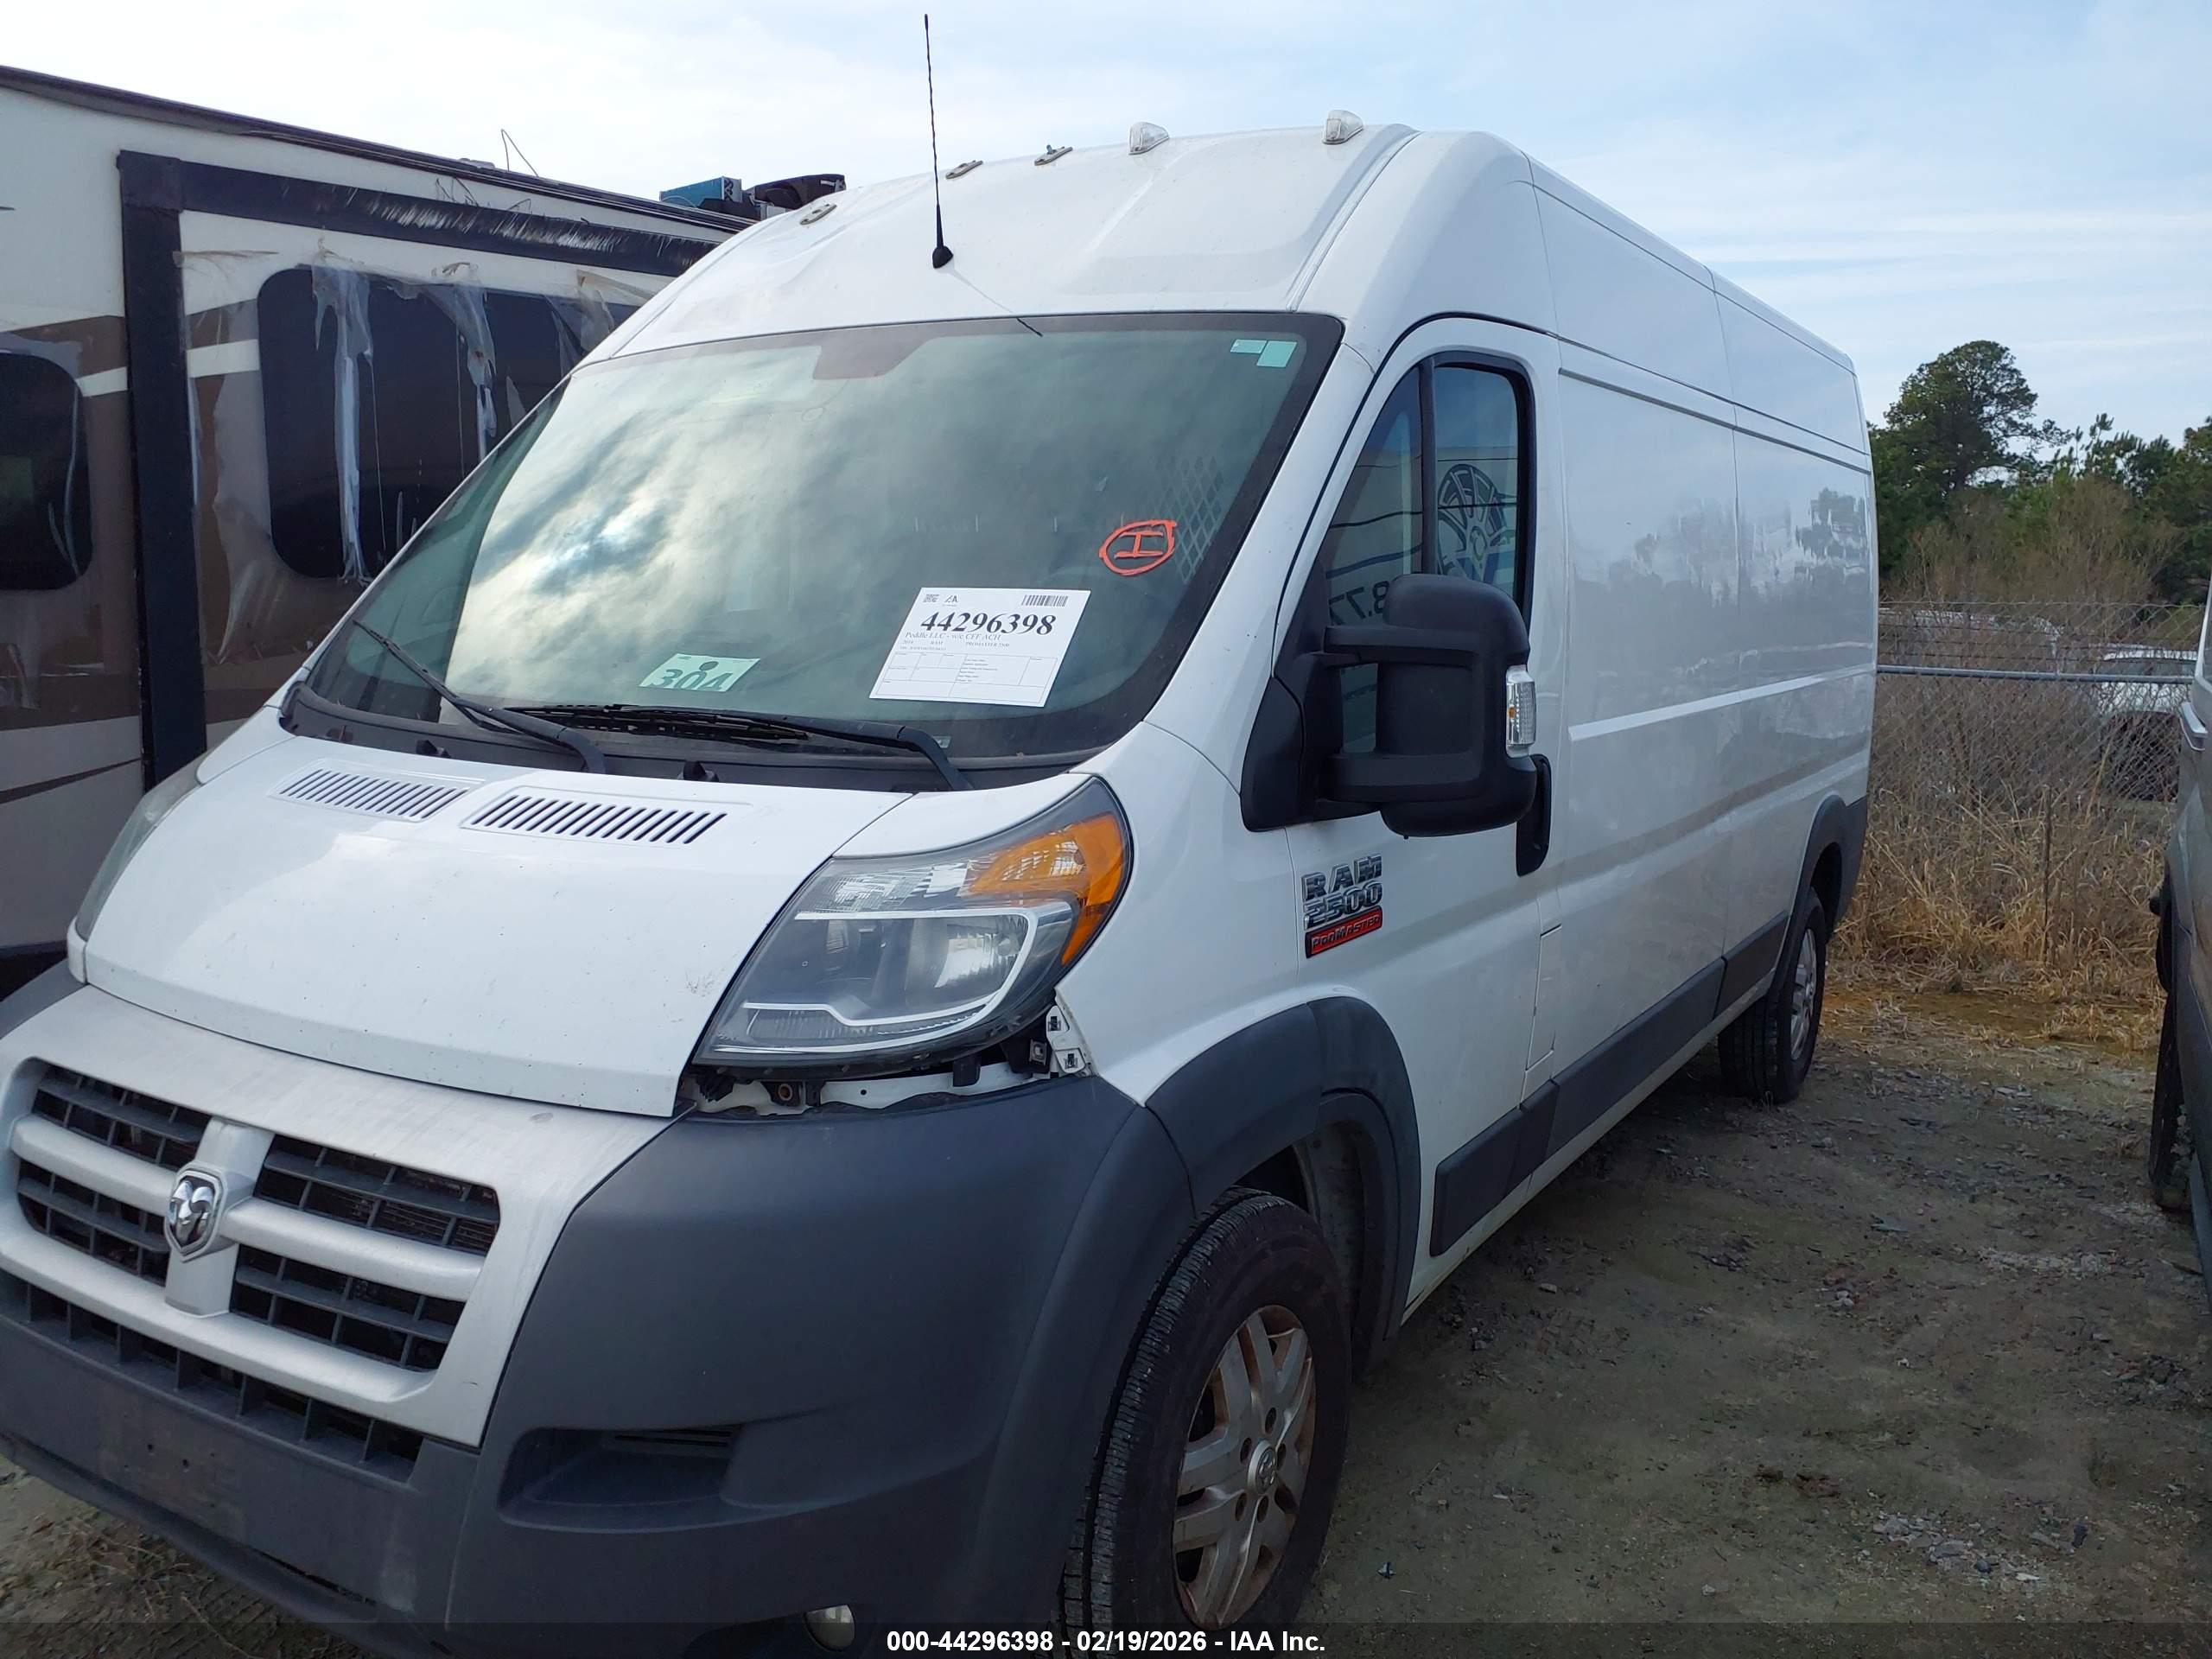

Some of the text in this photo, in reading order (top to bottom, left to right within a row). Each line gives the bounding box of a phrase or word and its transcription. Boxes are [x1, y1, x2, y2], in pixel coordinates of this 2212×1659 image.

[920, 612, 1057, 635] 44296398
[649, 669, 733, 690] 304
[1302, 855, 1382, 901] RAM
[1304, 881, 1382, 930] 2500
